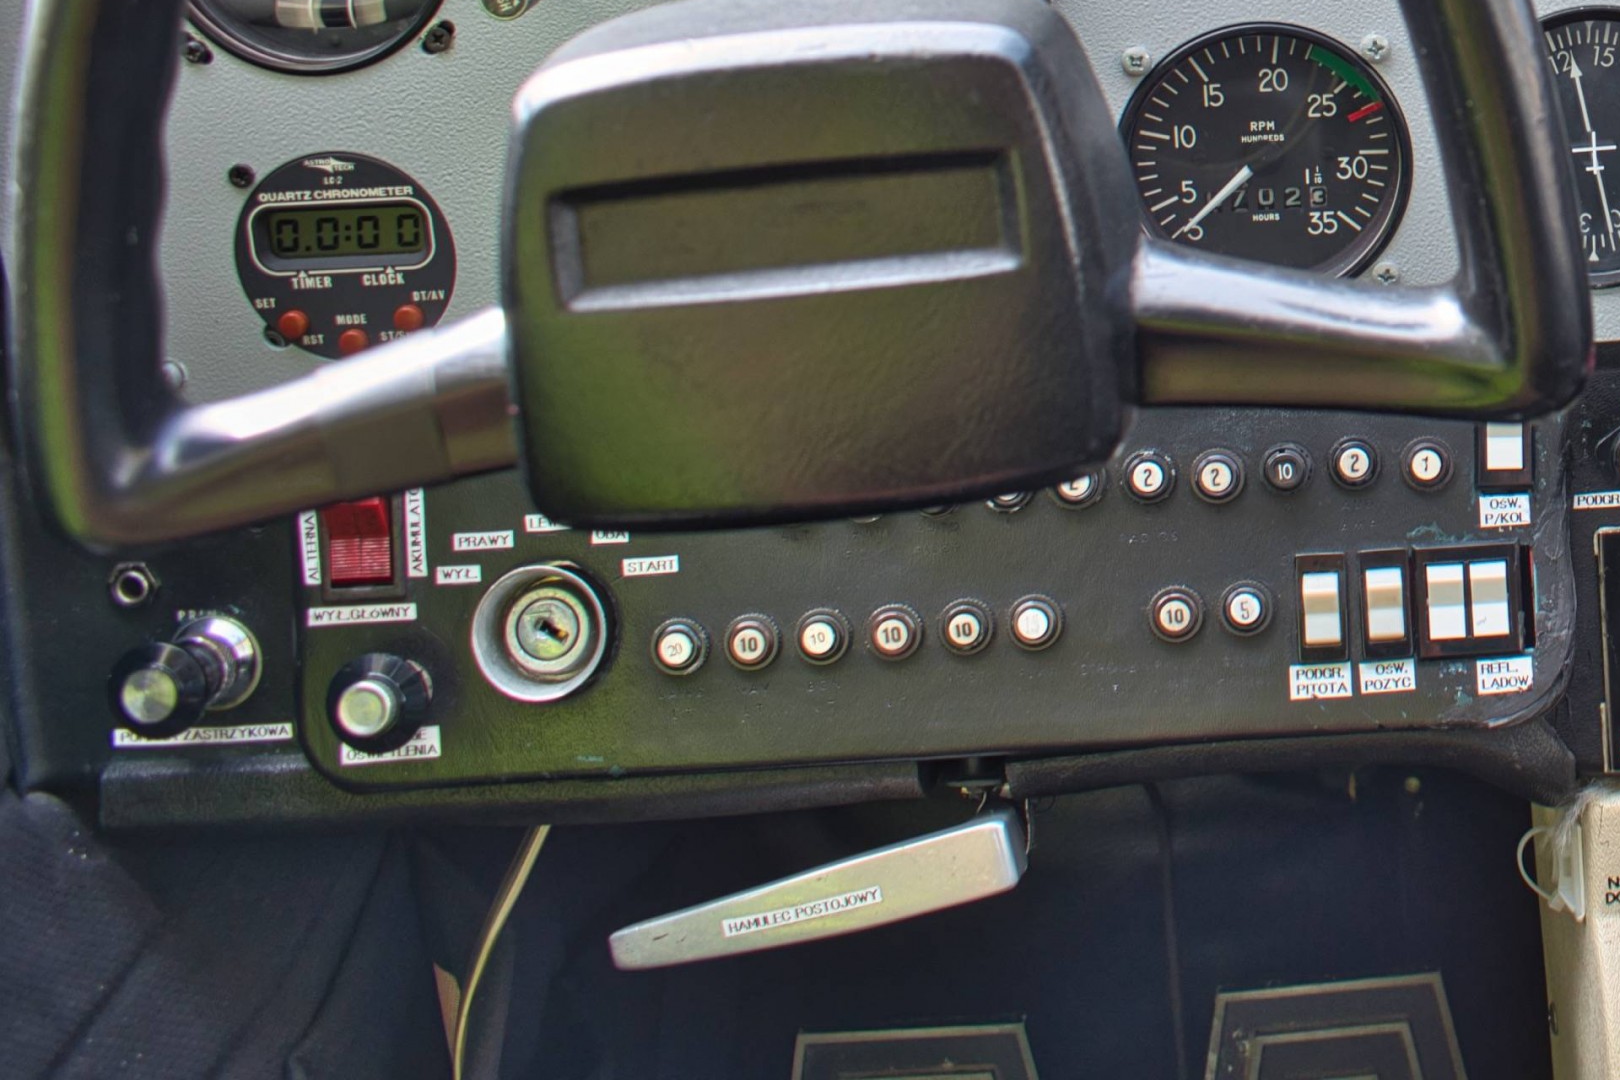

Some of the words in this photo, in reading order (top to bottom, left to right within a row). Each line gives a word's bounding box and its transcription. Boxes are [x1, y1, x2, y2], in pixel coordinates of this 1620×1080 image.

[1259, 69, 1288, 92] 20
[1203, 84, 1224, 108] 15
[1308, 94, 1337, 118] 25
[1250, 121, 1275, 132] RPM
[1174, 125, 1196, 148] 10
[1336, 157, 1367, 179] 30
[259, 191, 311, 202] QUARTZ
[314, 186, 413, 200] CHRONOMETER
[1252, 213, 1280, 221] HOURS
[1307, 212, 1338, 235] 35
[292, 277, 332, 289] TIMER
[362, 273, 405, 286] CLOCK
[255, 298, 275, 308] SET
[336, 315, 367, 325] MODE
[303, 335, 324, 345] RST
[458, 535, 509, 546] PRAWY
[627, 560, 675, 573] START
[1296, 668, 1345, 679] PODGR.
[1481, 662, 1518, 674] REFL.
[1297, 683, 1347, 694] PITOTA
[728, 910, 792, 934] HAMULEC
[795, 887, 879, 918] POSTOJOWY
